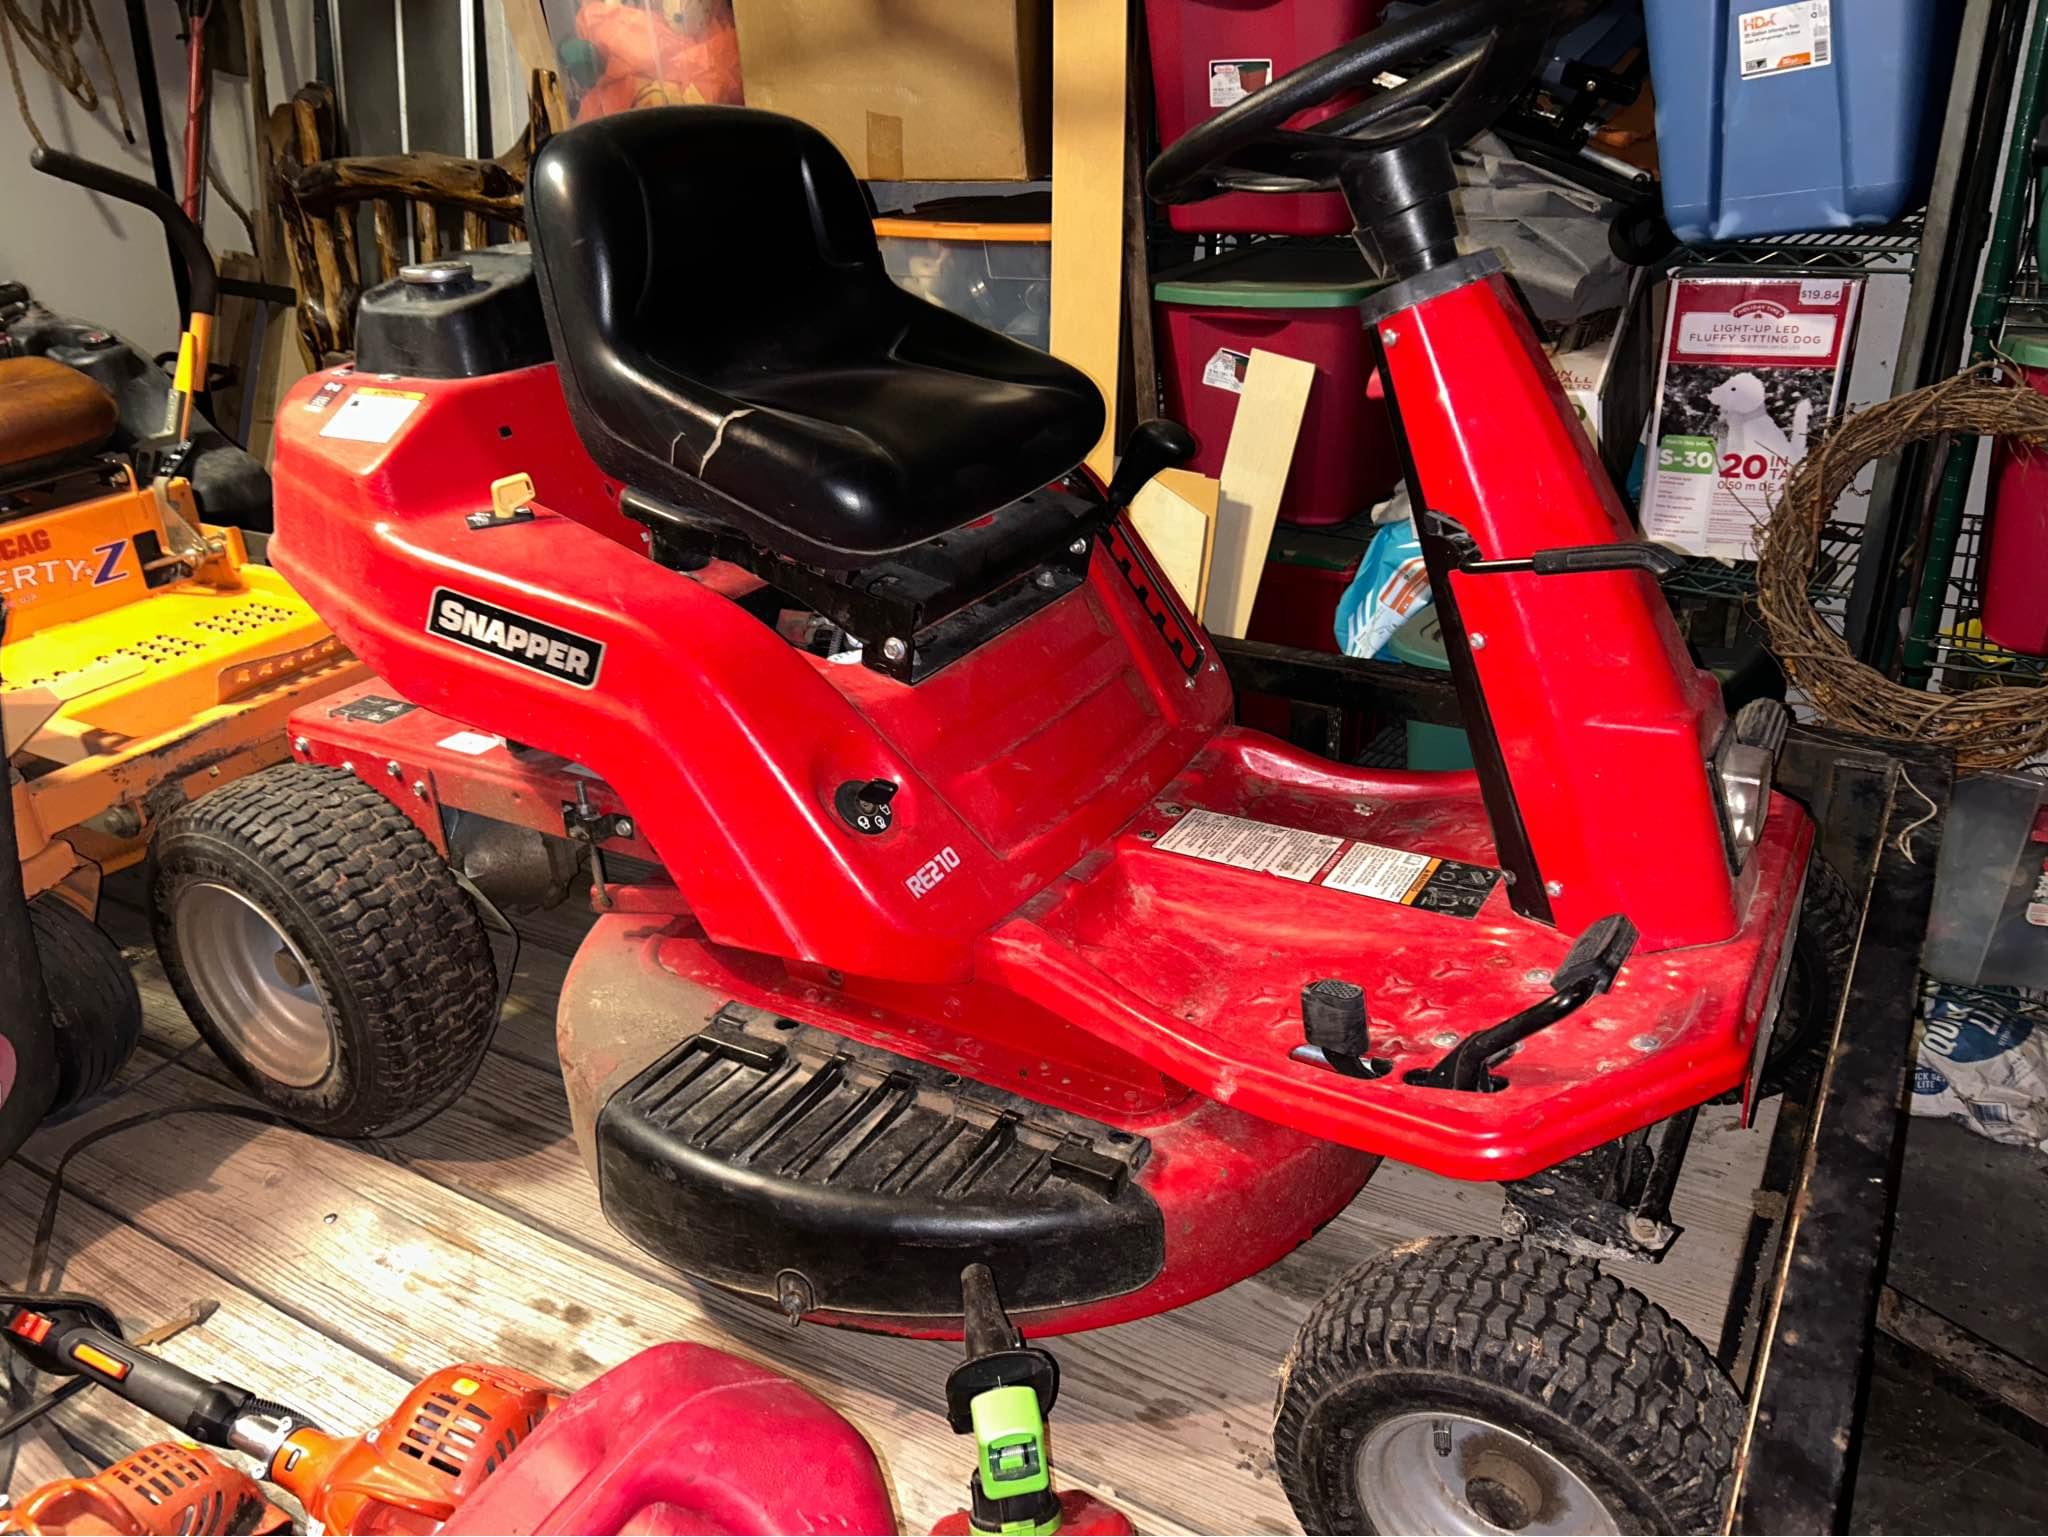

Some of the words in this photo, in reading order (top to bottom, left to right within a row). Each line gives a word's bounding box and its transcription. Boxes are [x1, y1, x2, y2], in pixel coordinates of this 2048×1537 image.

[1801, 289, 1839, 300] $19.84
[1713, 323, 1771, 333] LIGHT-UP
[1775, 325, 1800, 334] LED
[1689, 333, 1735, 343] FLUFFY
[1740, 334, 1788, 344] SITTING
[1792, 336, 1821, 344] DOG
[1659, 448, 1713, 468] S-30
[1719, 453, 1768, 480] 20
[438, 599, 591, 677] SNAPPER
[905, 846, 961, 899] RE210
[1917, 1080, 1936, 1089] LITE
